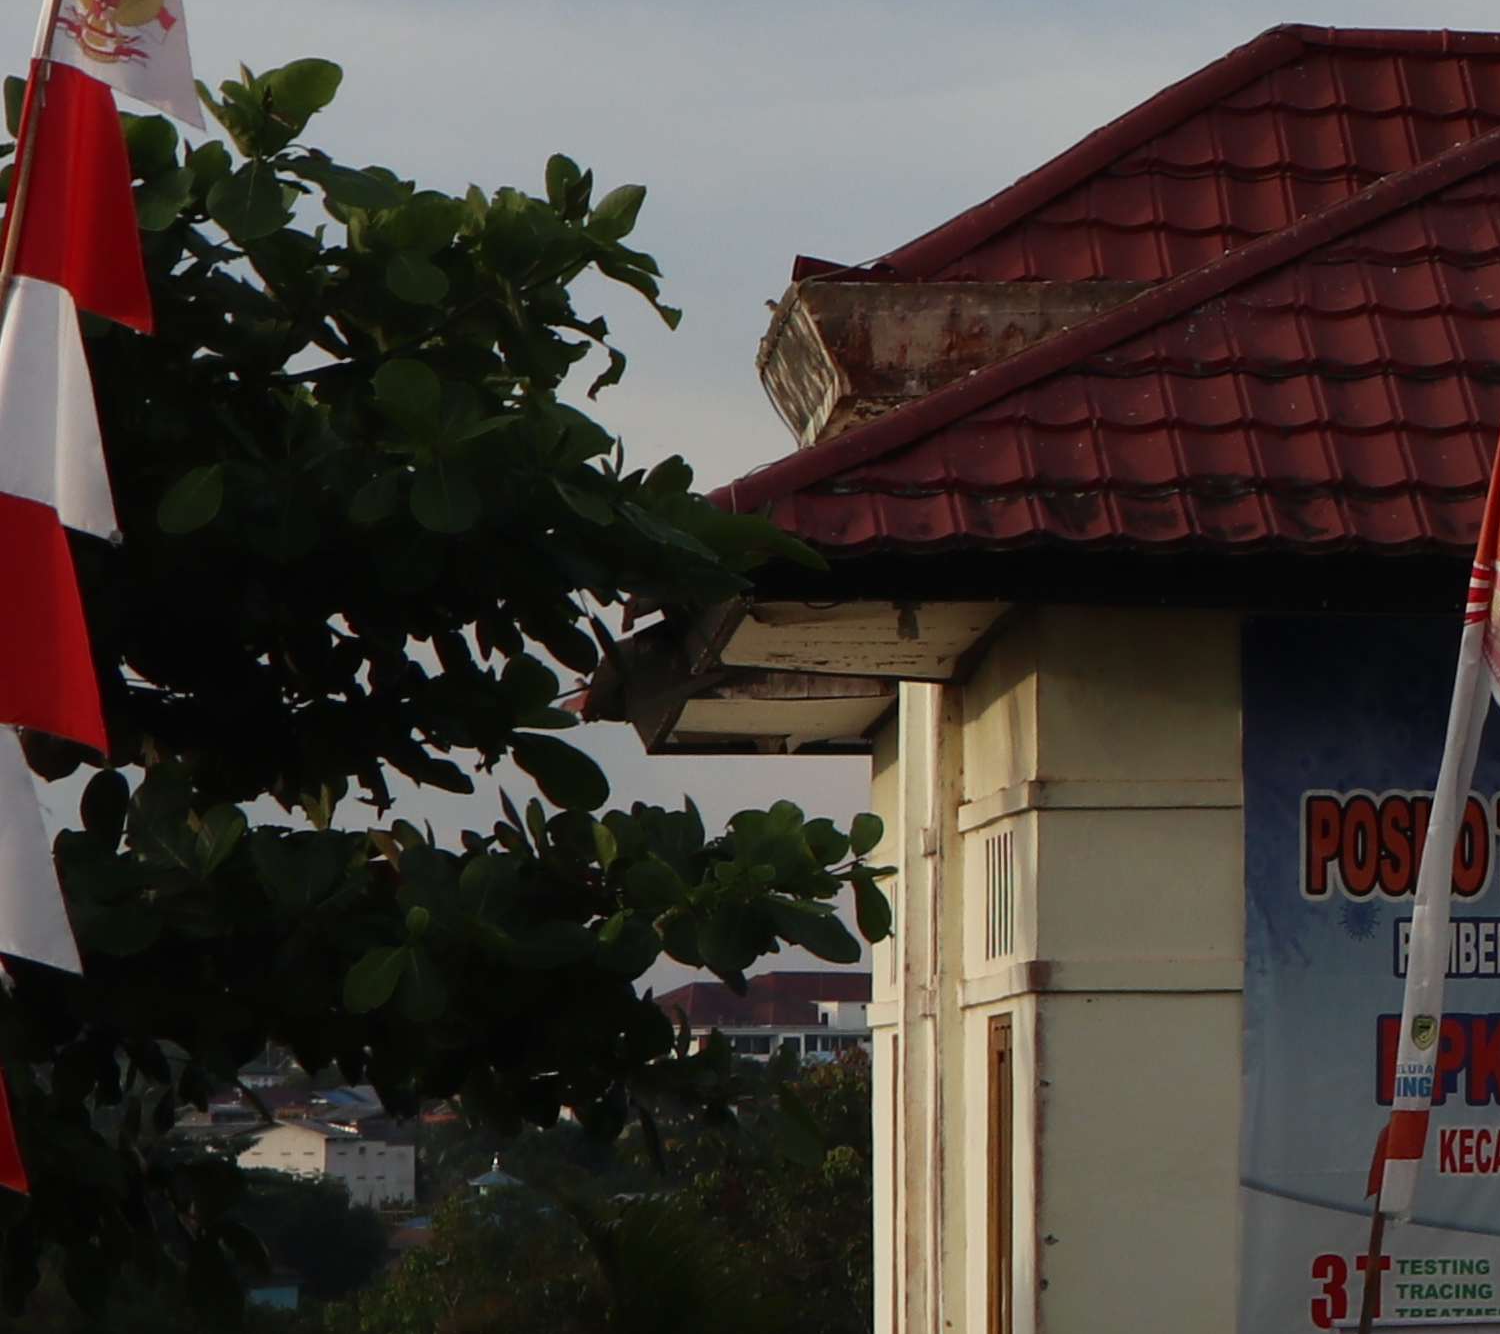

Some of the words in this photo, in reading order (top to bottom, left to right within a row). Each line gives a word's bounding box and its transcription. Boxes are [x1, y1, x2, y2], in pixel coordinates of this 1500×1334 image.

[1306, 795, 1490, 896] POSO
[1396, 1259, 1490, 1275] TESTING
[1395, 1284, 1493, 1299] TRACING
